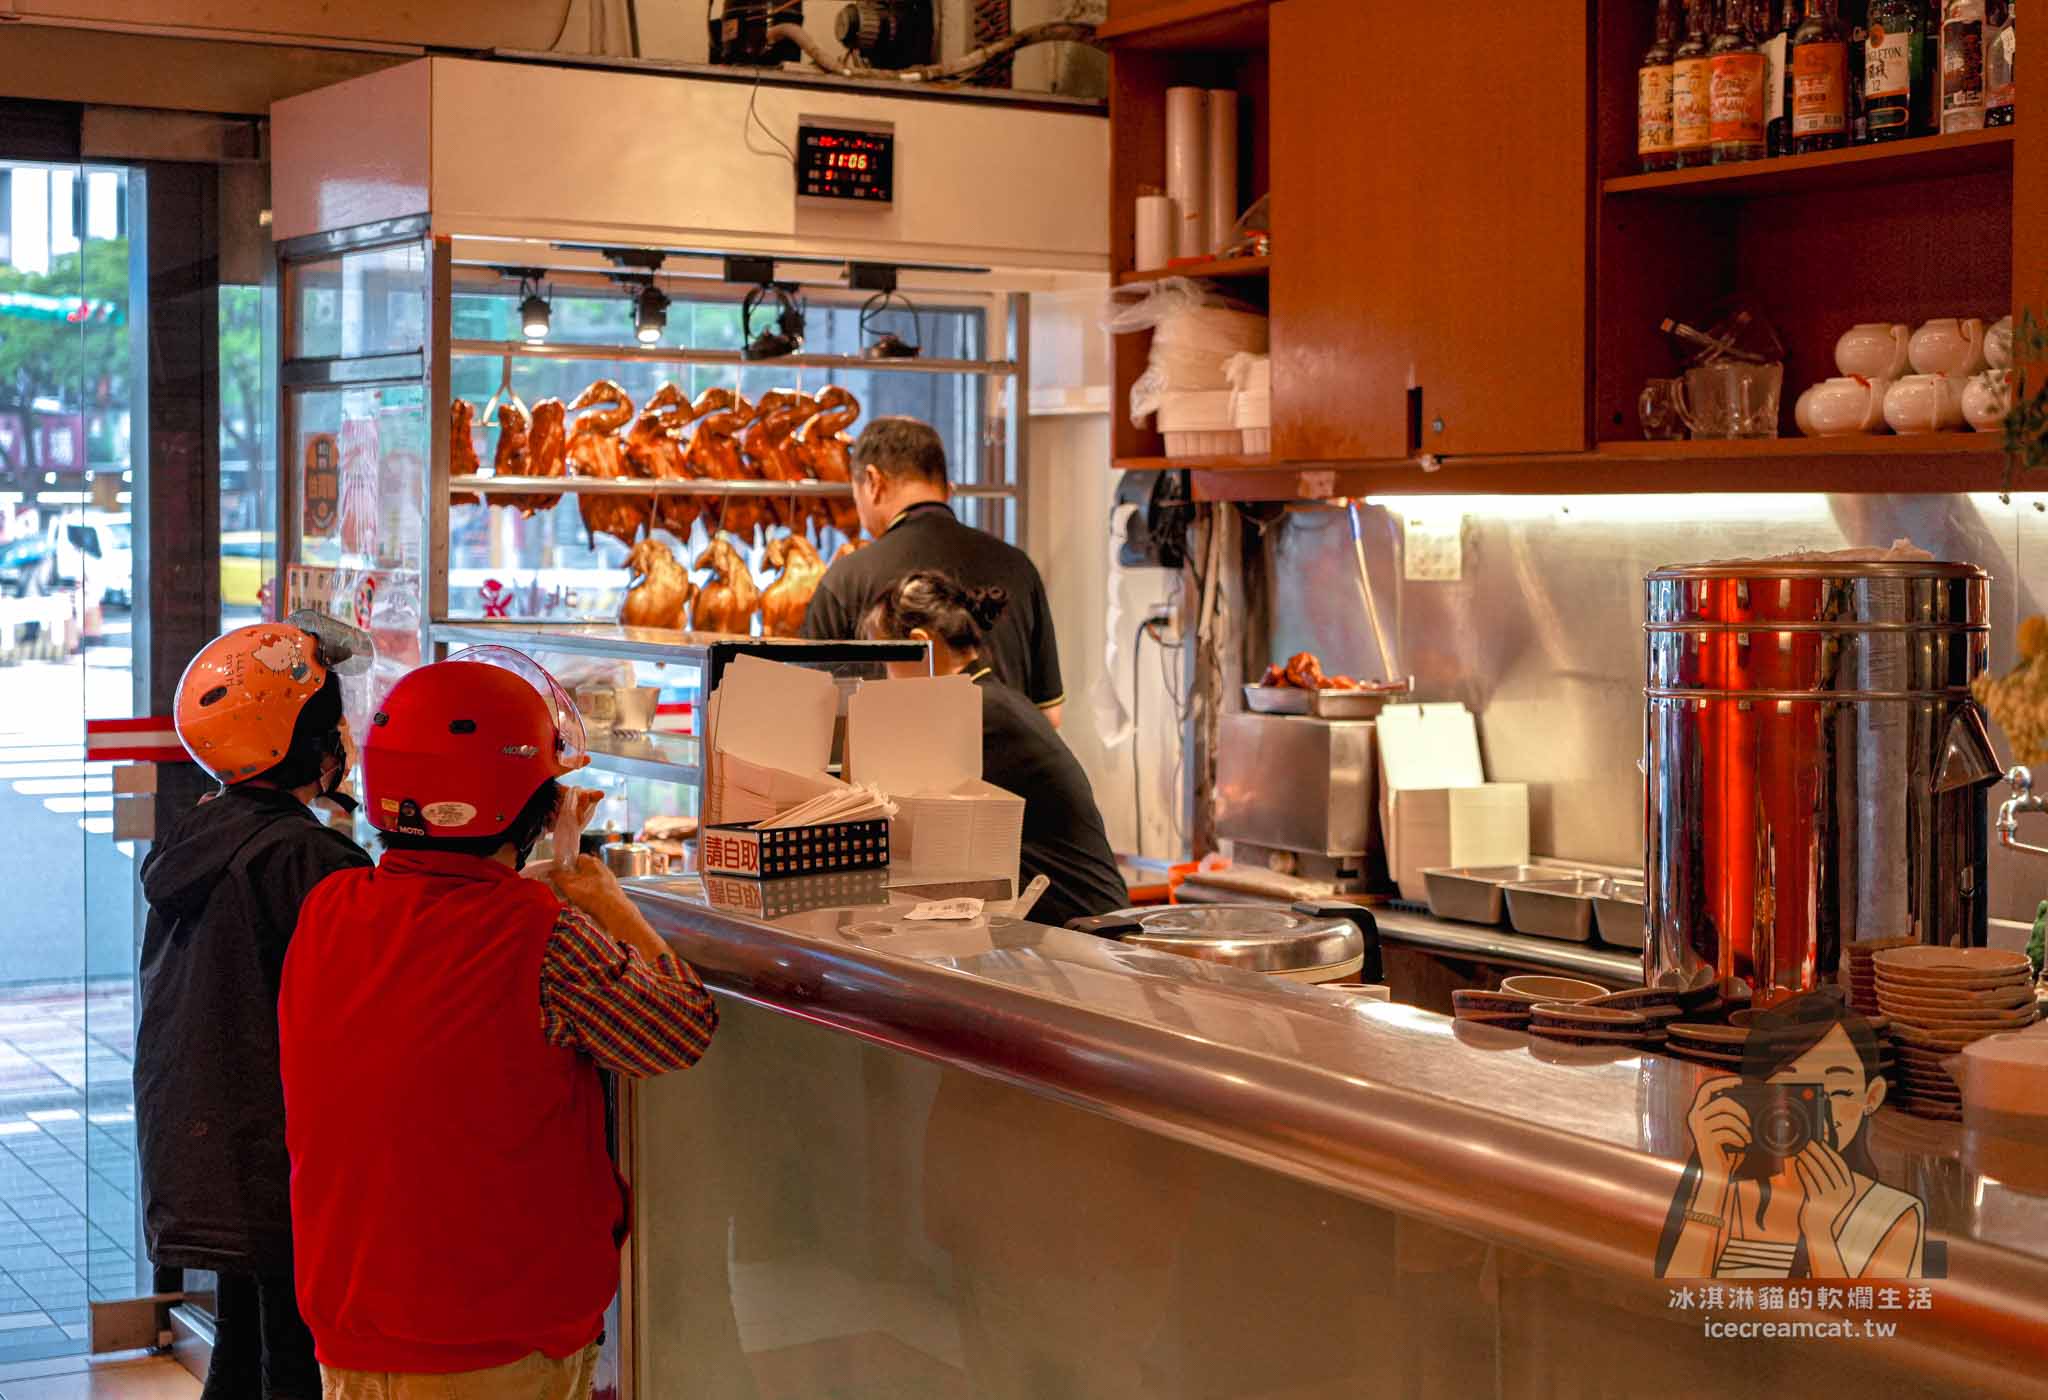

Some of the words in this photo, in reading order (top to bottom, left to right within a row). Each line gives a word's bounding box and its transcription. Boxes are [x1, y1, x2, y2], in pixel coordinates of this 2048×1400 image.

[828, 152, 867, 170] 11:06
[400, 826, 424, 836] MOTO
[706, 835, 758, 871] 請自取
